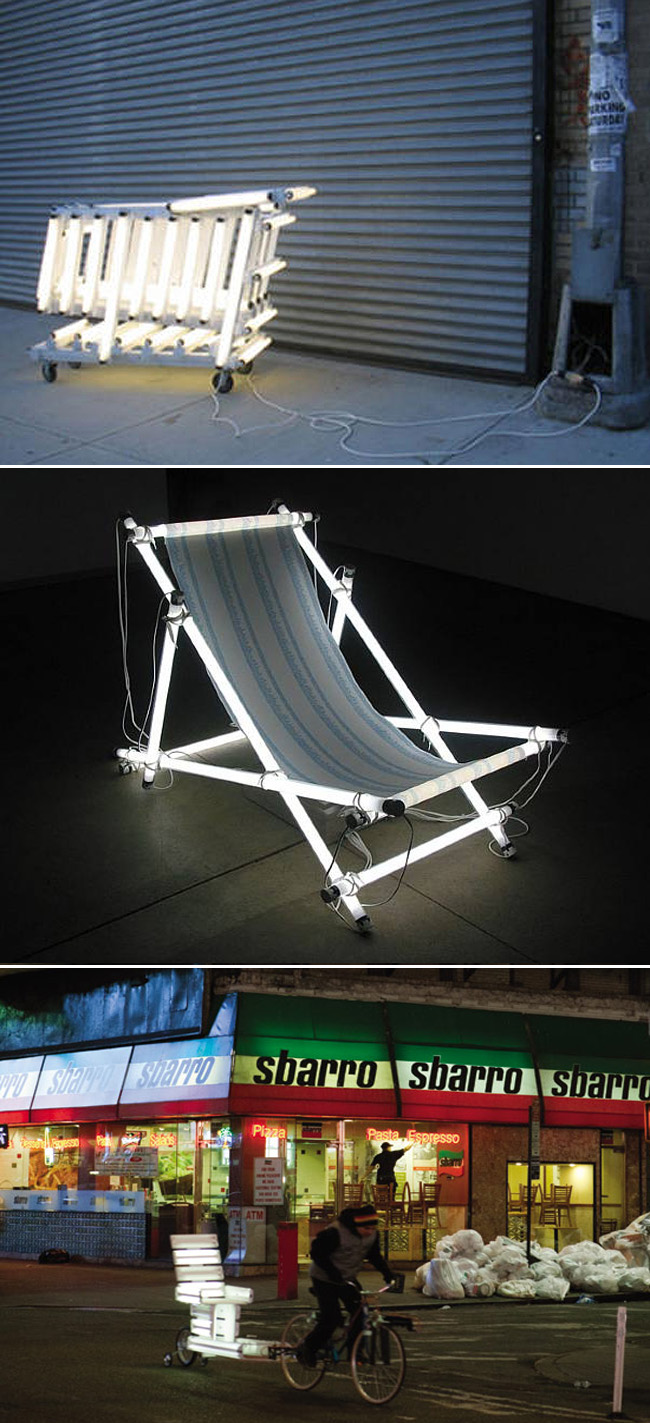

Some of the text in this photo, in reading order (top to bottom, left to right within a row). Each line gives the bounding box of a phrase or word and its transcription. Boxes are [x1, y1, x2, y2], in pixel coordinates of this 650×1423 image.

[594, 90, 610, 100] NO
[138, 1056, 215, 1088] sbarro
[253, 1050, 378, 1088] sbarro
[409, 1055, 523, 1094] sbarro
[551, 1065, 650, 1101] sbarro
[252, 1124, 286, 1139] Pizza
[367, 1128, 460, 1144] Pasta Espresso
[246, 1210, 264, 1220] ATM
